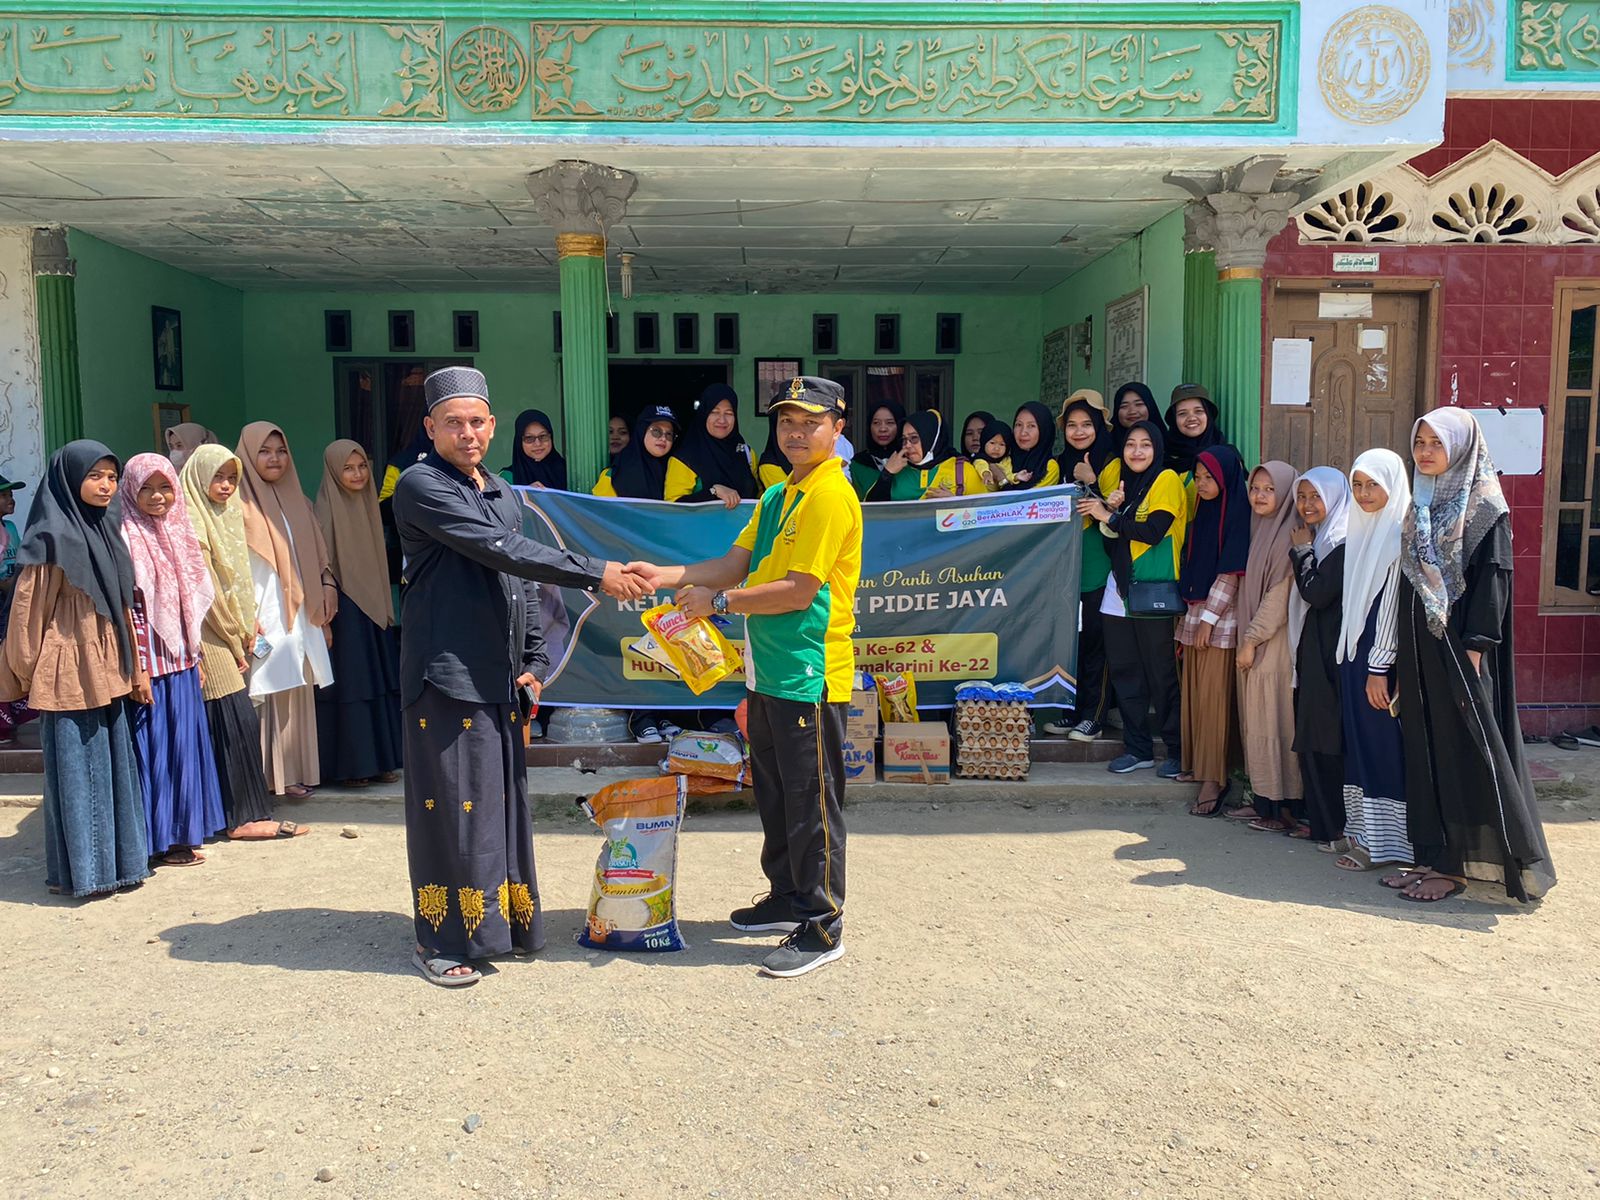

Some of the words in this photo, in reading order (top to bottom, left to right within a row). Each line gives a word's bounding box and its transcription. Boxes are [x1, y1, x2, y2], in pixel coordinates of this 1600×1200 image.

[977, 508, 1023, 521] BerAKHLAK
[883, 570, 933, 588] Panti
[937, 565, 1005, 585] Asuhan
[869, 593, 940, 614] PIDIE
[946, 588, 1008, 609] JAYA
[866, 640, 916, 656] Ke-62
[921, 638, 936, 654] &
[631, 660, 664, 673] HUT
[855, 659, 933, 673] rmakarini
[939, 657, 989, 672] Ke-22
[636, 821, 674, 830] BUMN
[644, 938, 658, 949] 10
[659, 936, 671, 947] Kg
